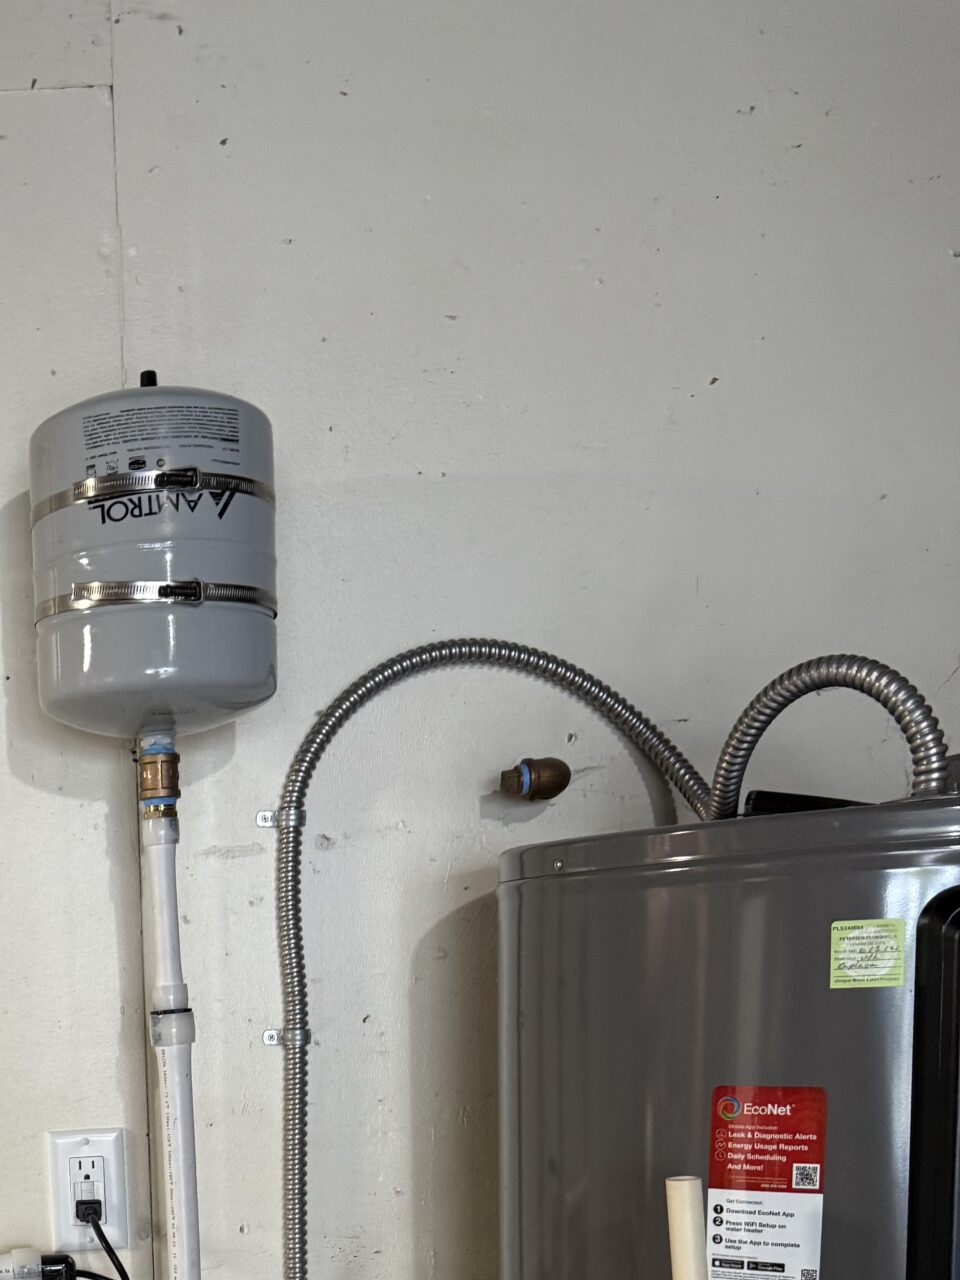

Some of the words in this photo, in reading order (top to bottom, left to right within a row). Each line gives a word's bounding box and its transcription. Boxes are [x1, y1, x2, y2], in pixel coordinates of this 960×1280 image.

[100, 493, 205, 525] AMTROL
[743, 1103, 791, 1115] EcoNet
[754, 1132, 792, 1141] Diagnostic
[728, 1142, 752, 1150] Energy
[754, 1142, 777, 1151] Usage
[779, 1144, 809, 1152] Reports
[727, 1152, 745, 1160] Daily
[746, 1153, 787, 1162] Scheduling
